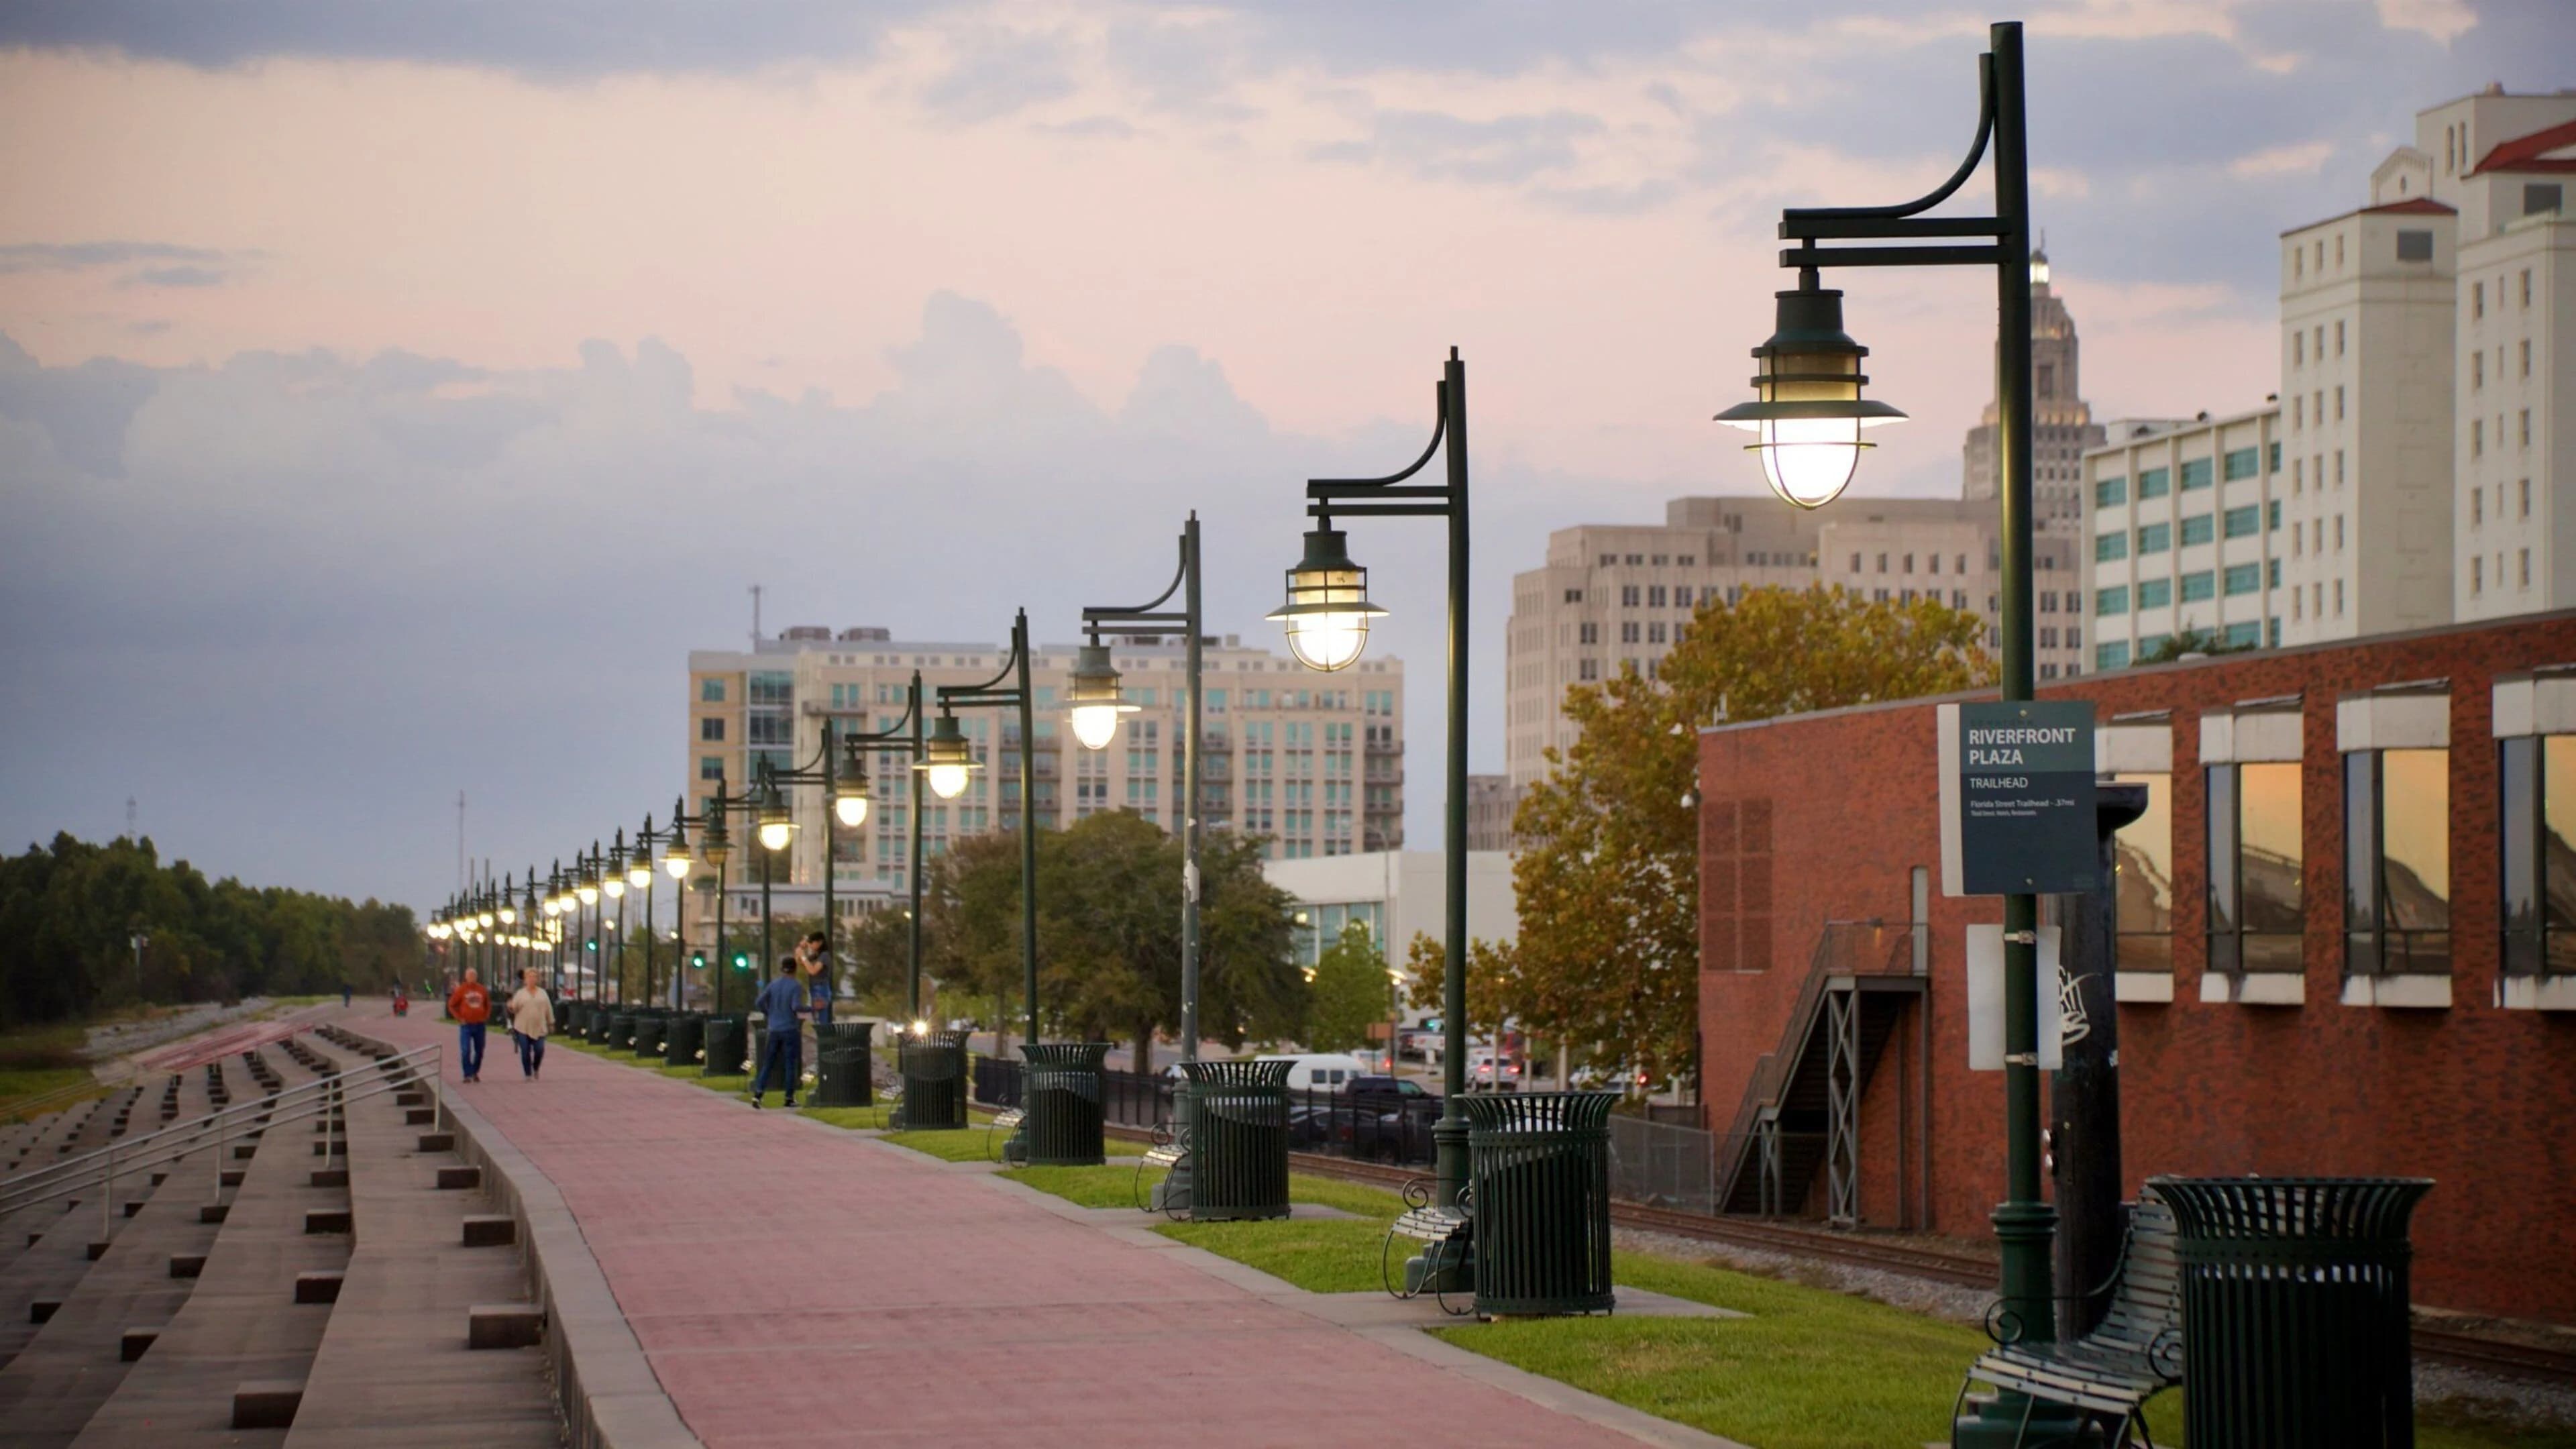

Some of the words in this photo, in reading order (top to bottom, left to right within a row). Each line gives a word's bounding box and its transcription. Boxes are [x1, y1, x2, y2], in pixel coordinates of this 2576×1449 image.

[1969, 728, 2076, 745] RIVERFRONT
[1969, 749, 2023, 765] PLAZA
[1970, 777, 2028, 789] TRAILHEAD
[2017, 799, 2049, 807] Trailhead
